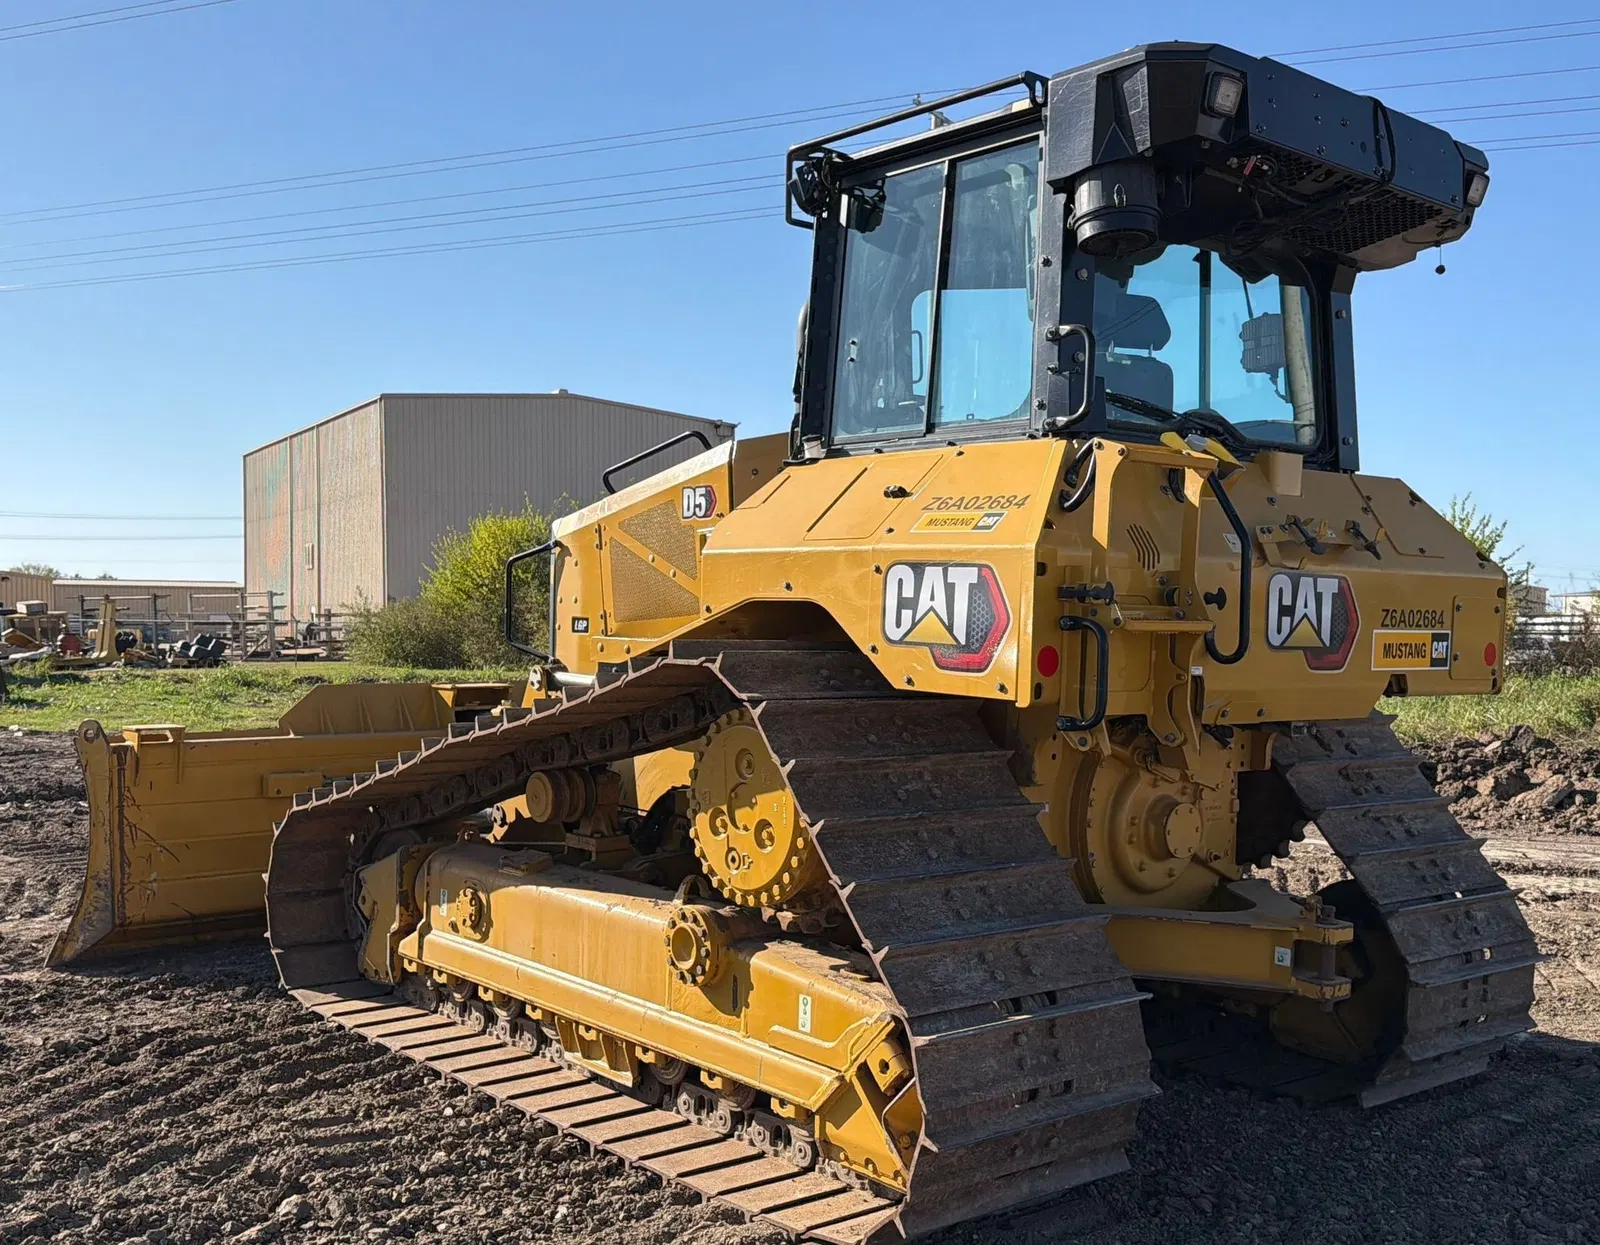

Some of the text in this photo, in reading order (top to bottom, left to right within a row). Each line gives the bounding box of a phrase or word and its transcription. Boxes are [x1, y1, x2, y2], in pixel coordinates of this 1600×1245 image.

[682, 487, 707, 517] D5
[921, 494, 1031, 511] Z6A02684
[925, 516, 1001, 527] MUSTANG CAT
[884, 564, 979, 646] CAT
[1268, 573, 1339, 647] CAT
[574, 619, 588, 631] LGP
[1380, 608, 1445, 629] Z6A02684
[1382, 641, 1448, 660] MUSTANG CAT
